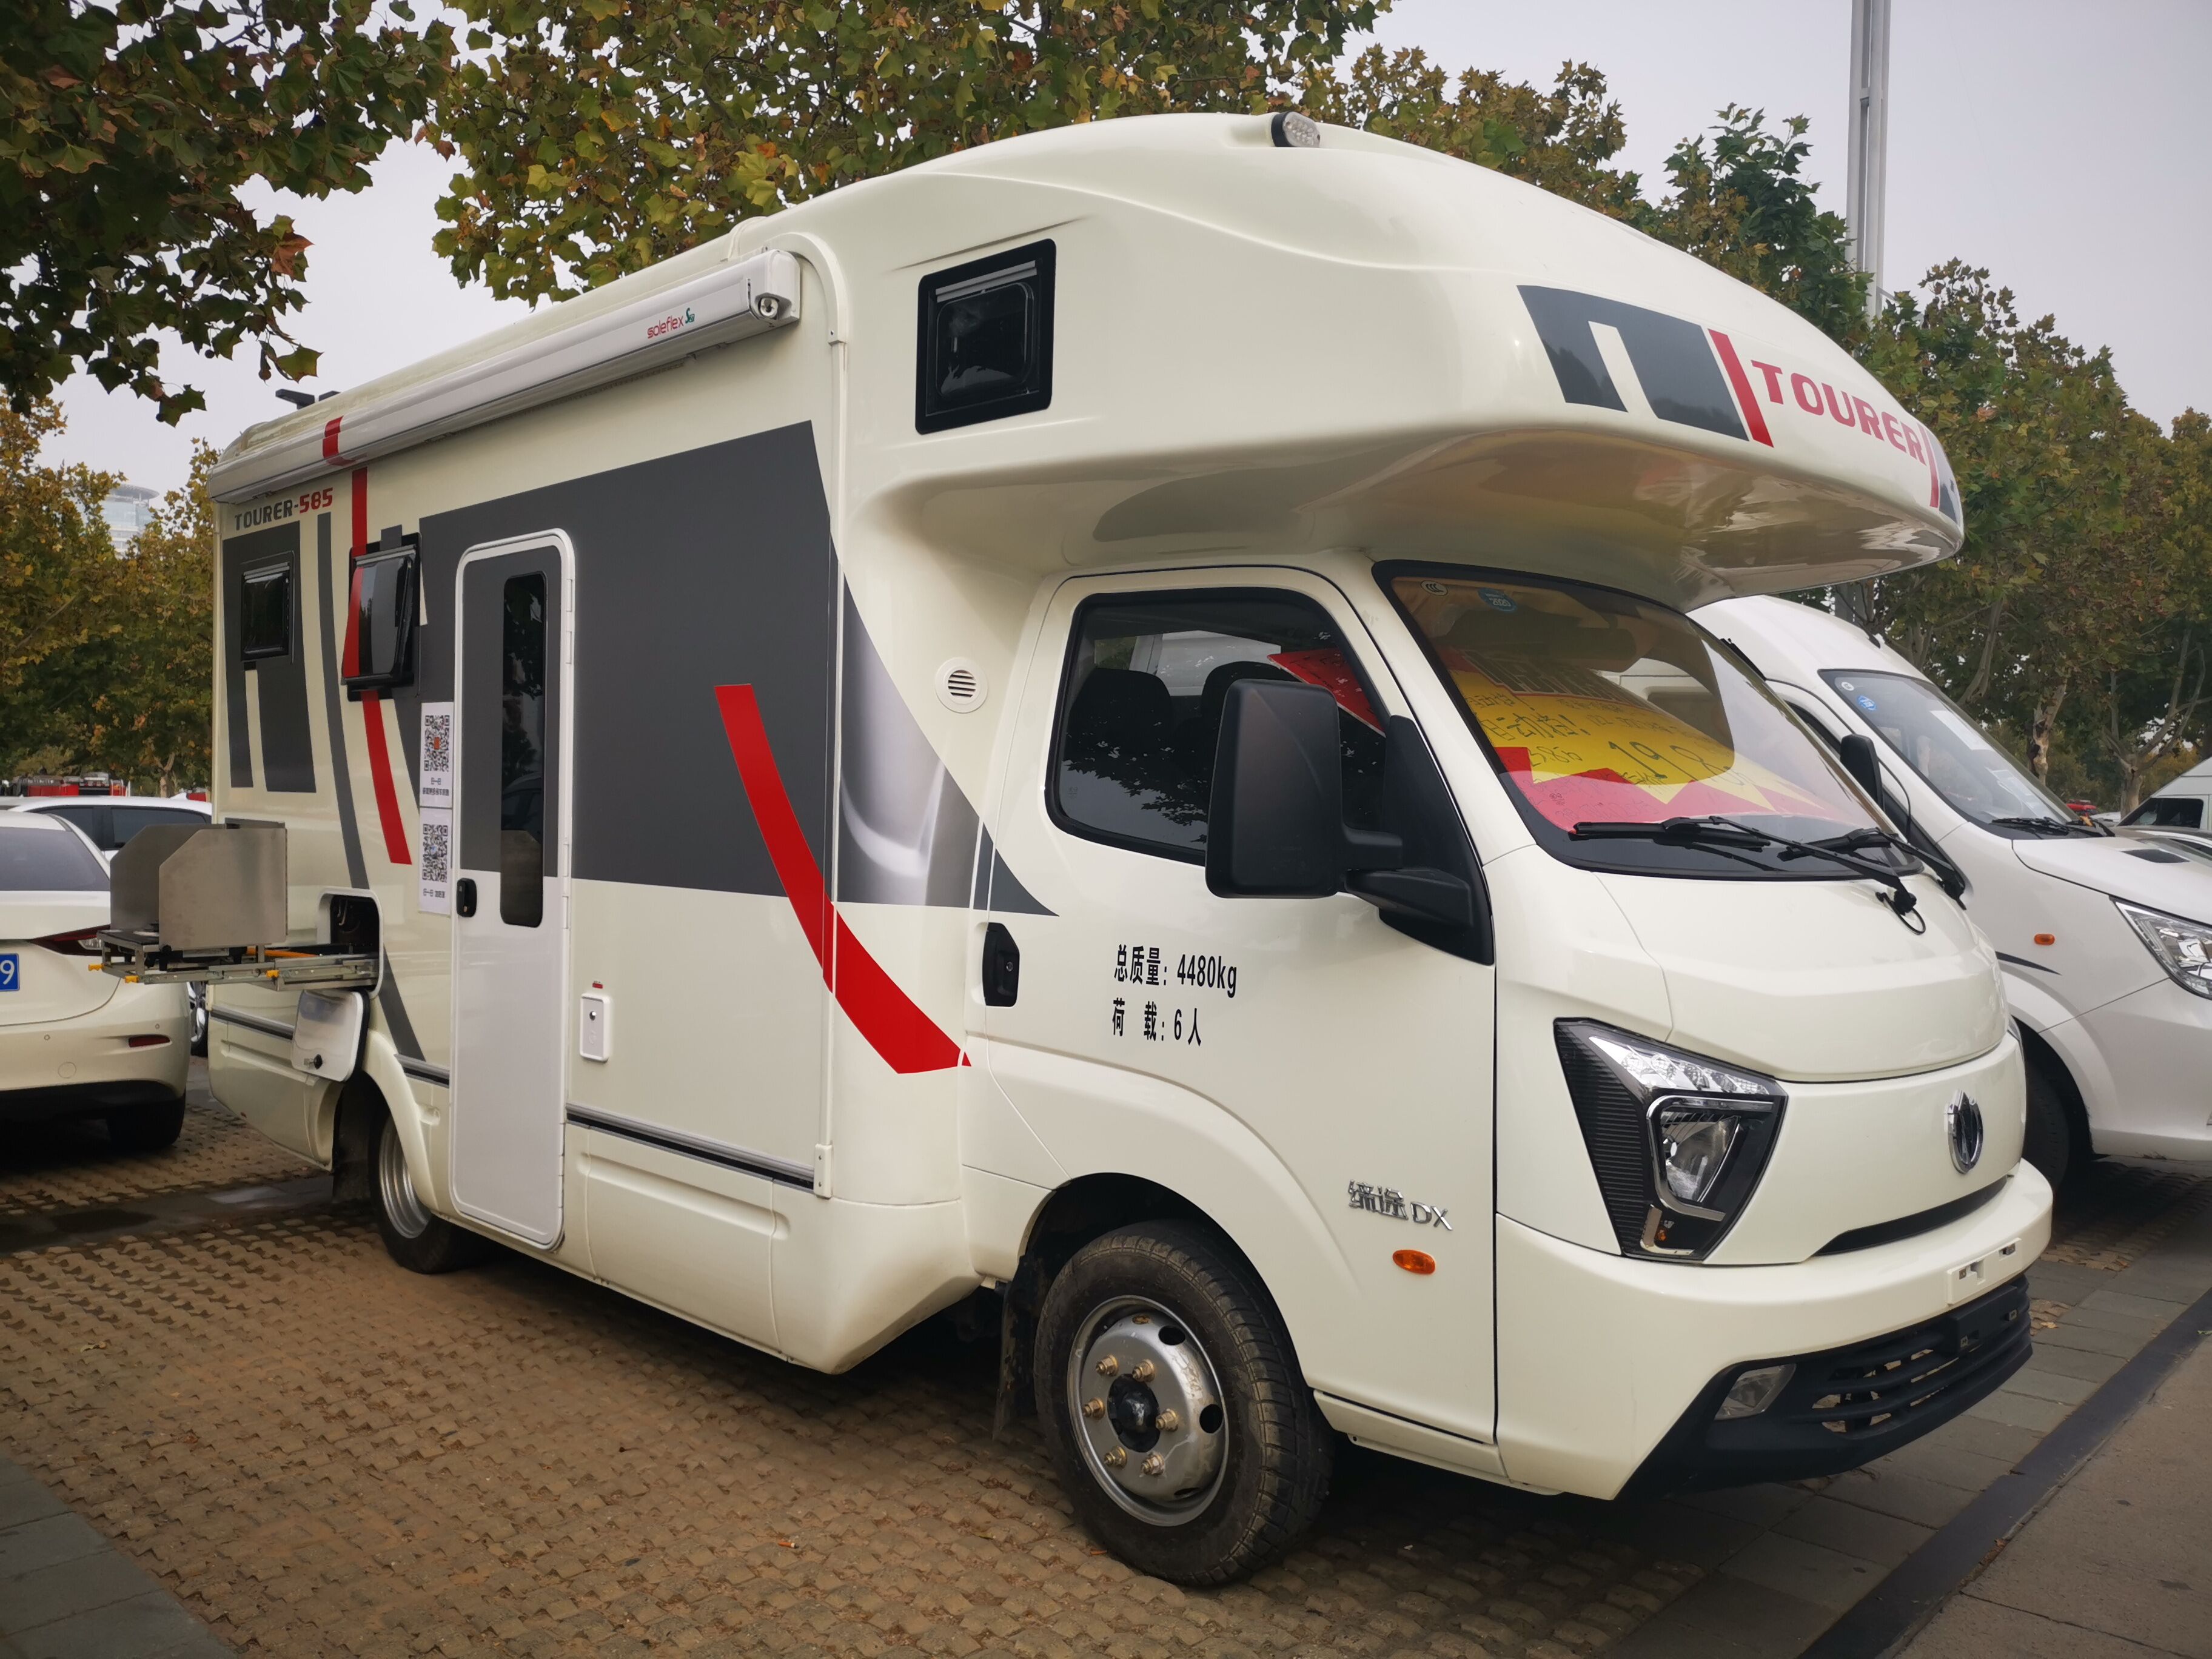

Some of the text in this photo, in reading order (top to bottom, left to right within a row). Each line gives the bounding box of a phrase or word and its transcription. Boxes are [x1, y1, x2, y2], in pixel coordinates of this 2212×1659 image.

[647, 315, 684, 339] soleflex
[1750, 360, 1927, 466] TOURER
[235, 487, 333, 531] TOURER-585
